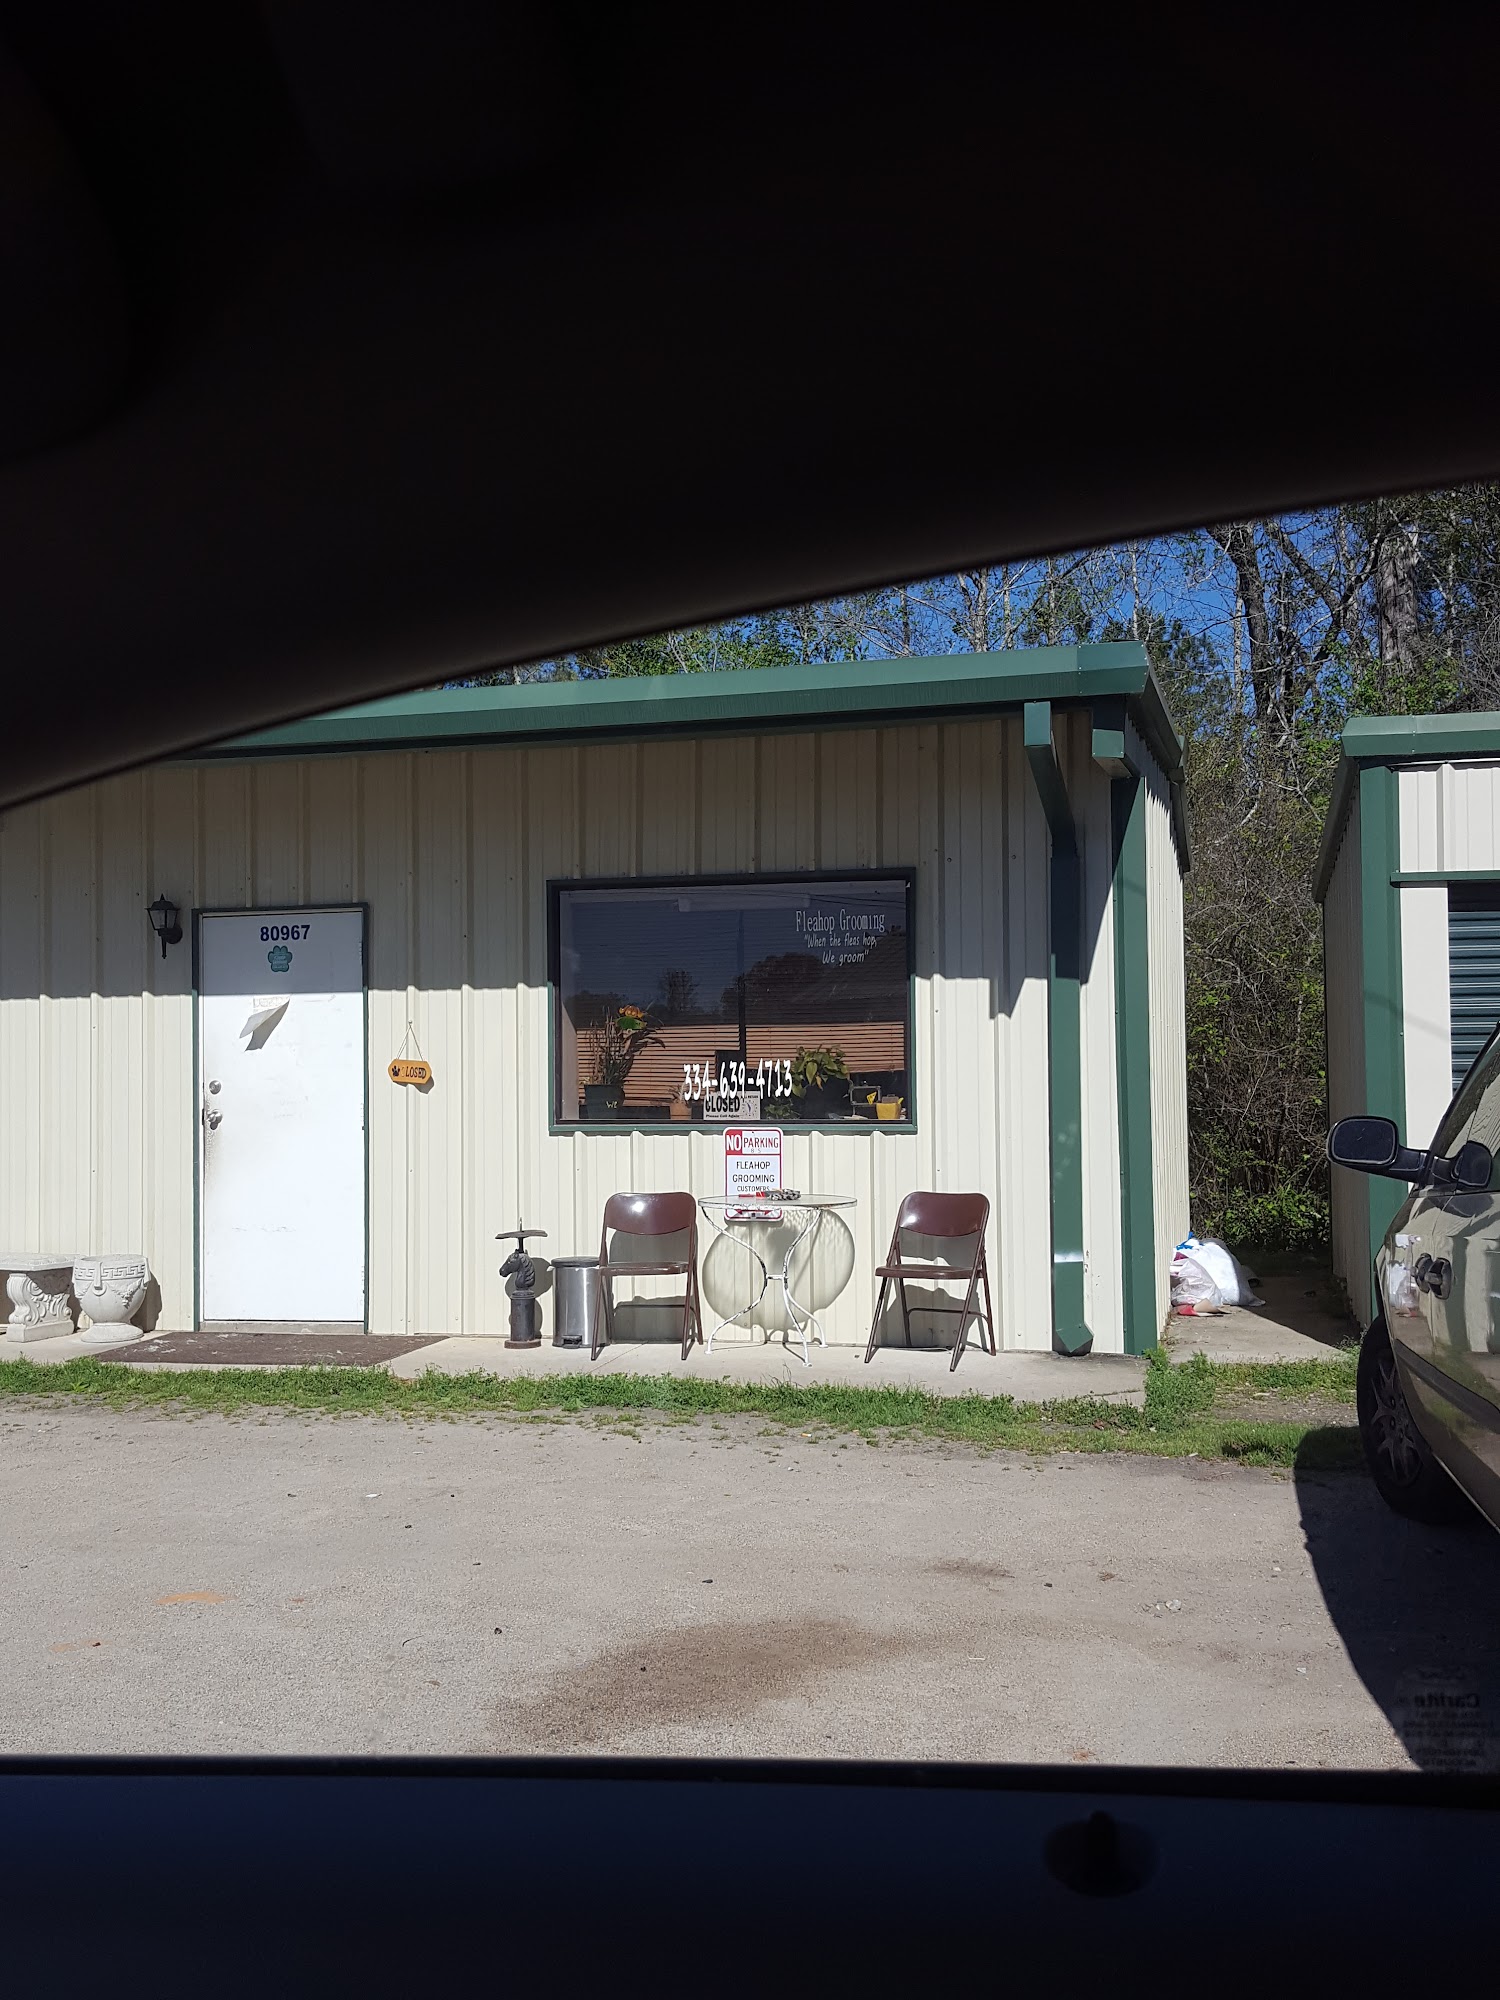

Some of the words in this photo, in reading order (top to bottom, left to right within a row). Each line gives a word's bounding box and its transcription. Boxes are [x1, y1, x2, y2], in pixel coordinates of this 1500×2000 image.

[796, 910, 835, 934] Fleahop
[840, 909, 885, 932] Grooming
[260, 924, 311, 941] 80967
[829, 933, 842, 946] the
[844, 932, 860, 947] fleas
[822, 950, 835, 964] We
[683, 1058, 793, 1101] 334-639-4713
[726, 1134, 742, 1151] NO
[743, 1137, 779, 1148] PARKING
[736, 1161, 771, 1170] FLEAHOP
[732, 1174, 775, 1183] GROOMING
